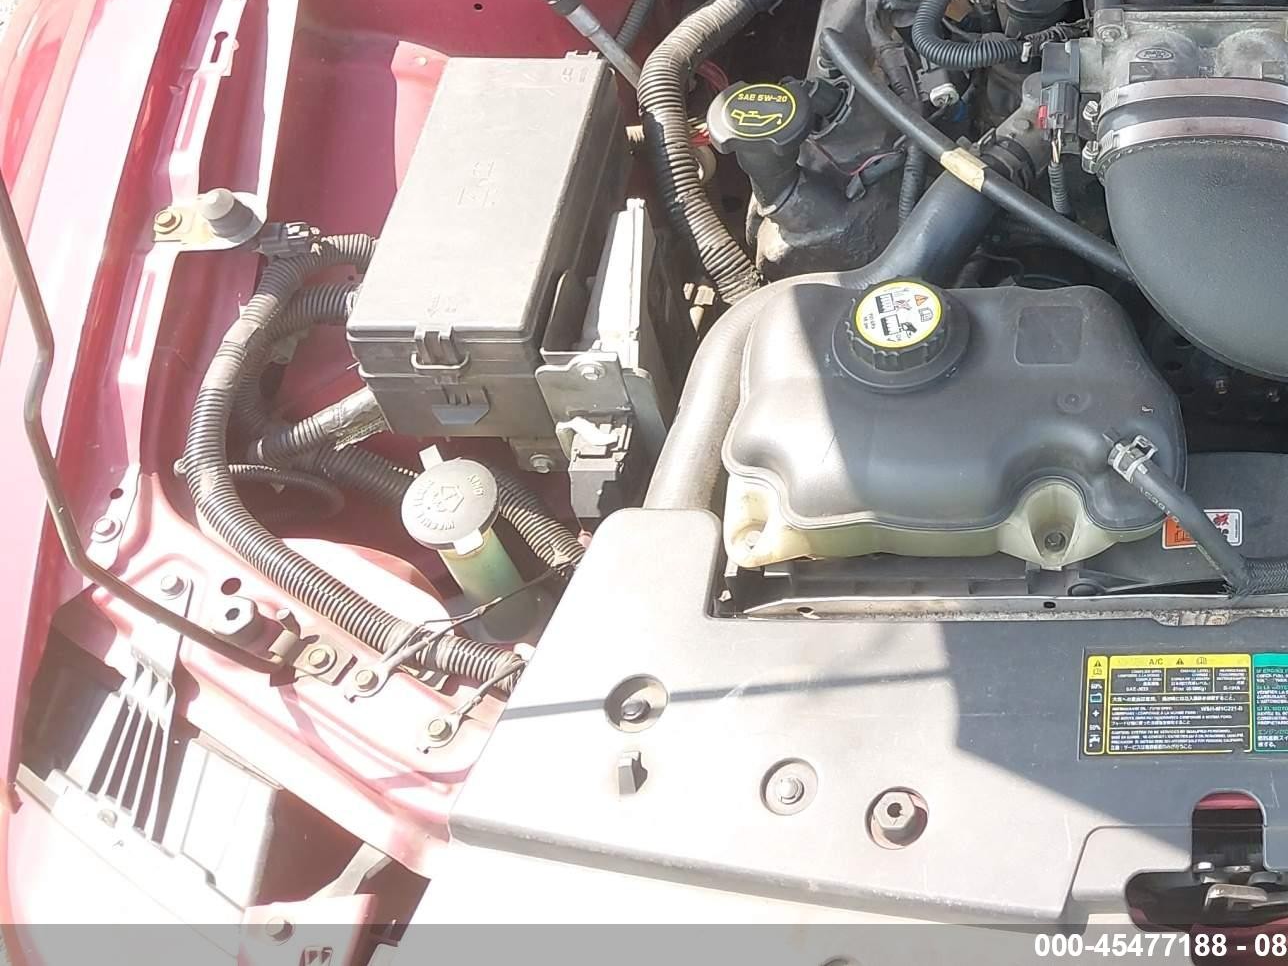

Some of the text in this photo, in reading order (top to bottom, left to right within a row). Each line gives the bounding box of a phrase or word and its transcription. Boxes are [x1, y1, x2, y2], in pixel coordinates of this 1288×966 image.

[738, 93, 788, 103] SAE 5W-20
[1149, 658, 1164, 666] A/C
